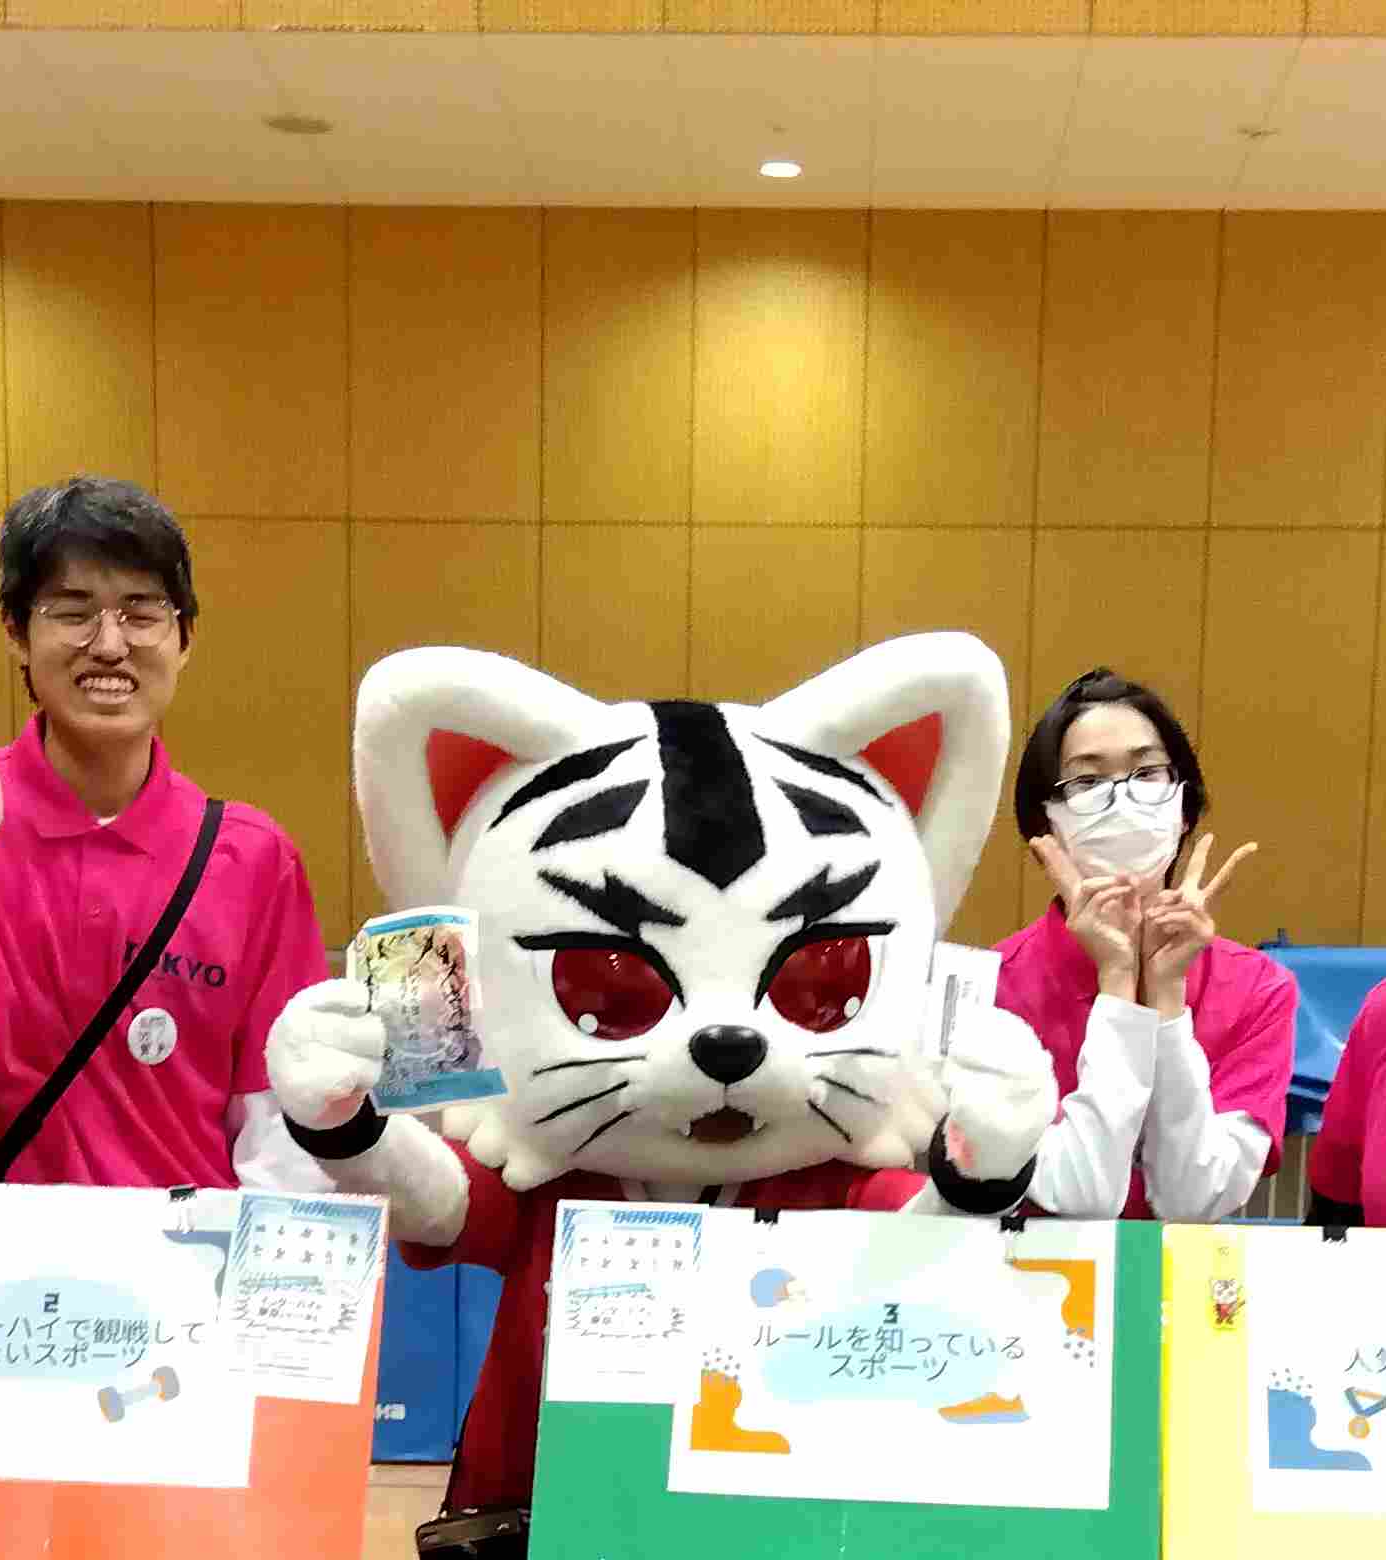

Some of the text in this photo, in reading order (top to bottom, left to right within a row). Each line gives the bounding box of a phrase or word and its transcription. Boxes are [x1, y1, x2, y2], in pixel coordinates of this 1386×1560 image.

[123, 938, 226, 988] TKYO
[43, 1292, 60, 1314] 2
[882, 1303, 900, 1325] 3
[752, 1323, 1026, 1361] ルールを知っている
[827, 1353, 949, 1381] スポーツ
